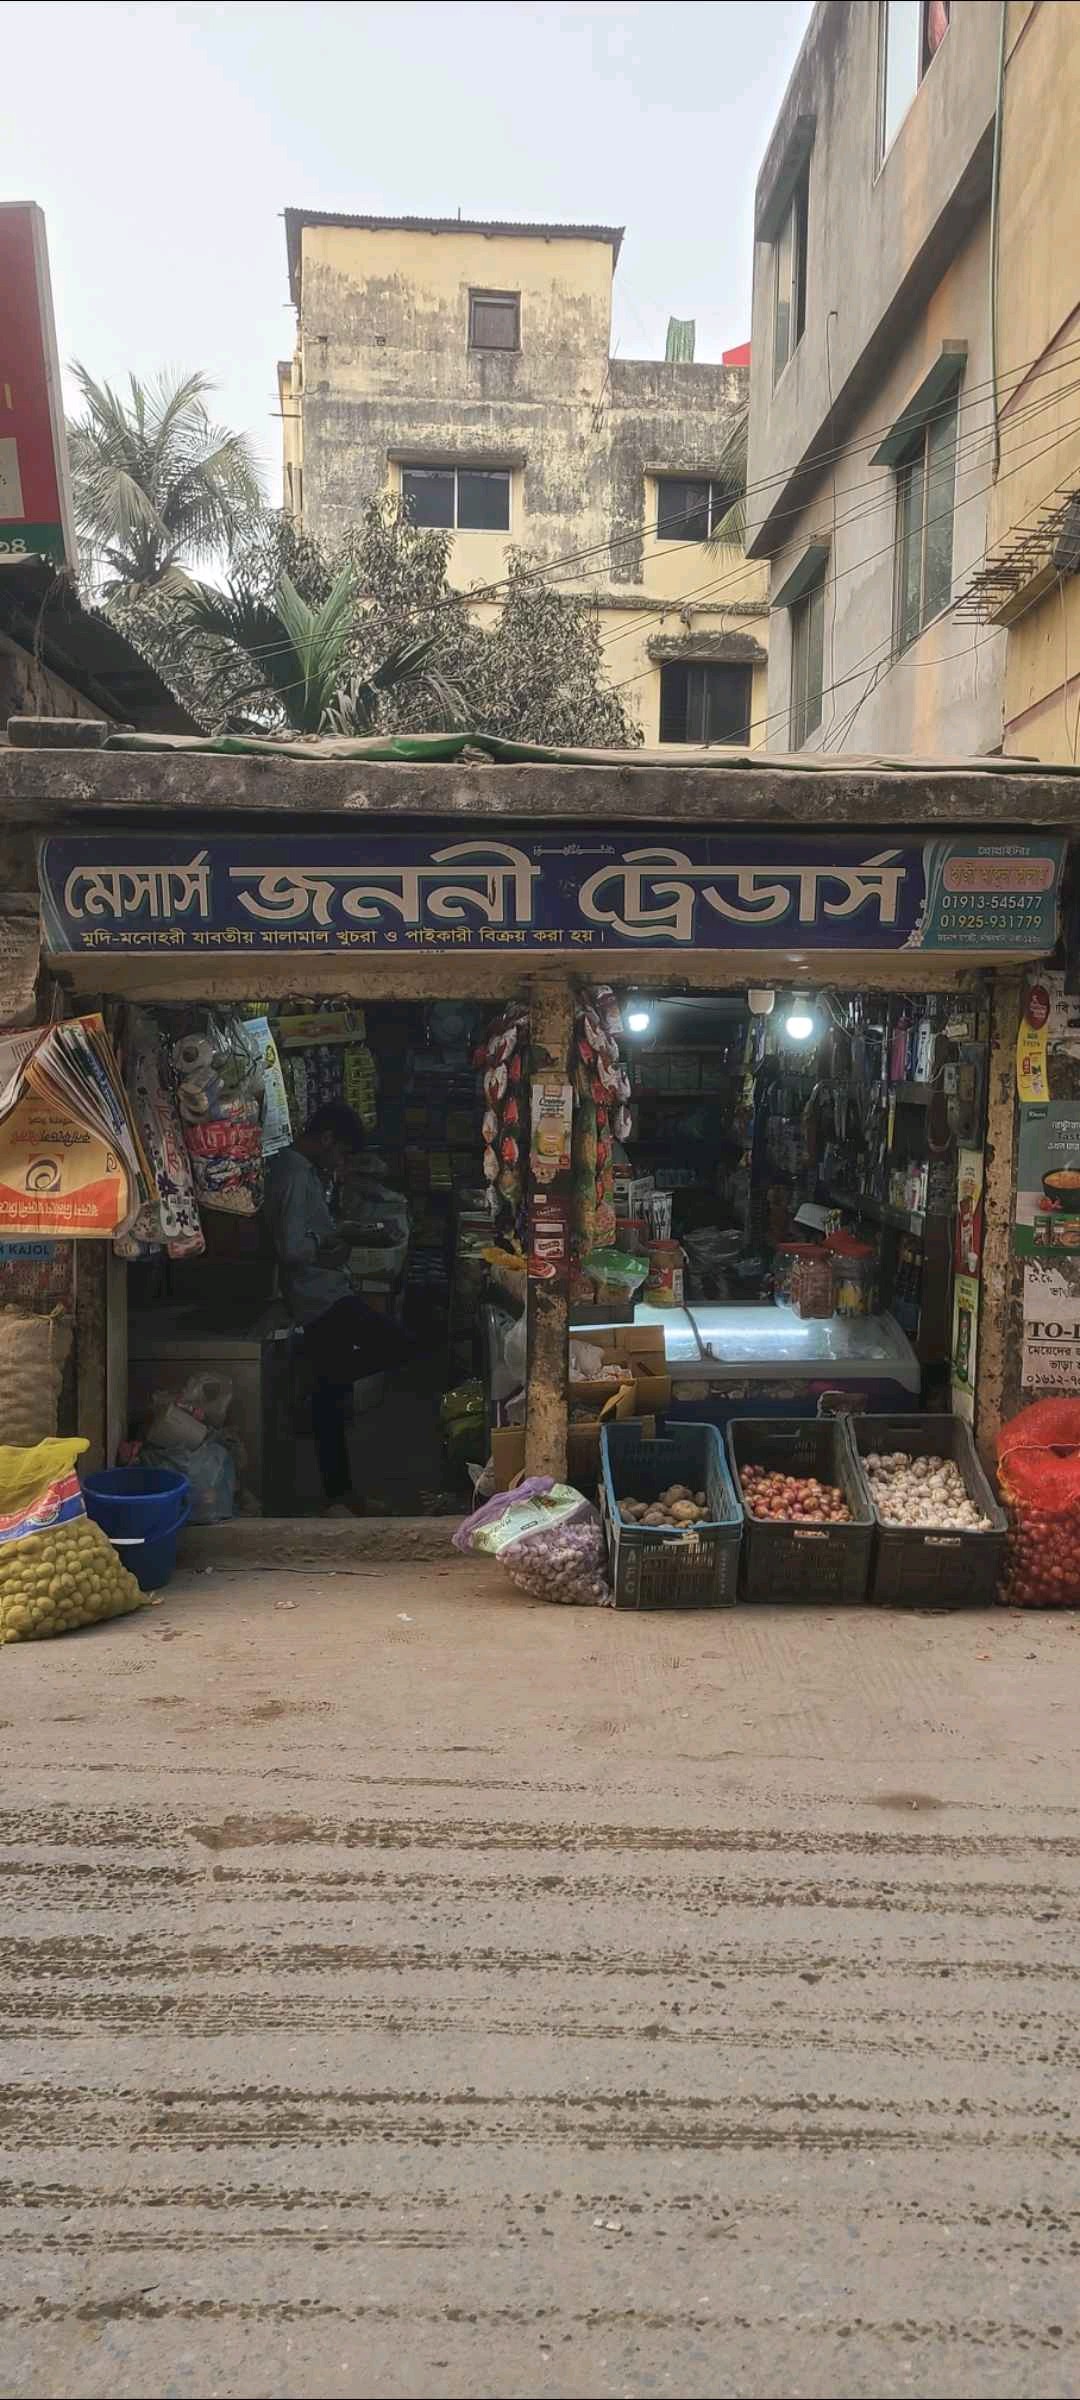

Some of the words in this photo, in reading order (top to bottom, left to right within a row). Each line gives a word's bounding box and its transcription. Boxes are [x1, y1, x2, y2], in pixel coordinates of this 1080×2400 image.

[64, 850, 211, 920] মেসার্স
[229, 841, 541, 925] জননী
[578, 847, 906, 940] ট্রেডার্স
[942, 896, 1042, 909] 01913-545477
[940, 915, 1042, 929] 01925-931779
[82, 928, 186, 947] মুদি-মনোহরী
[193, 928, 253, 945] যাবতীয়
[261, 929, 328, 944] মালামাল
[337, 928, 376, 945] খুচরা
[385, 931, 399, 943] ও
[405, 927, 472, 942] পাইকারী
[480, 926, 527, 943] বিক্রয়
[533, 928, 564, 942] করা
[569, 928, 594, 943] হয়
